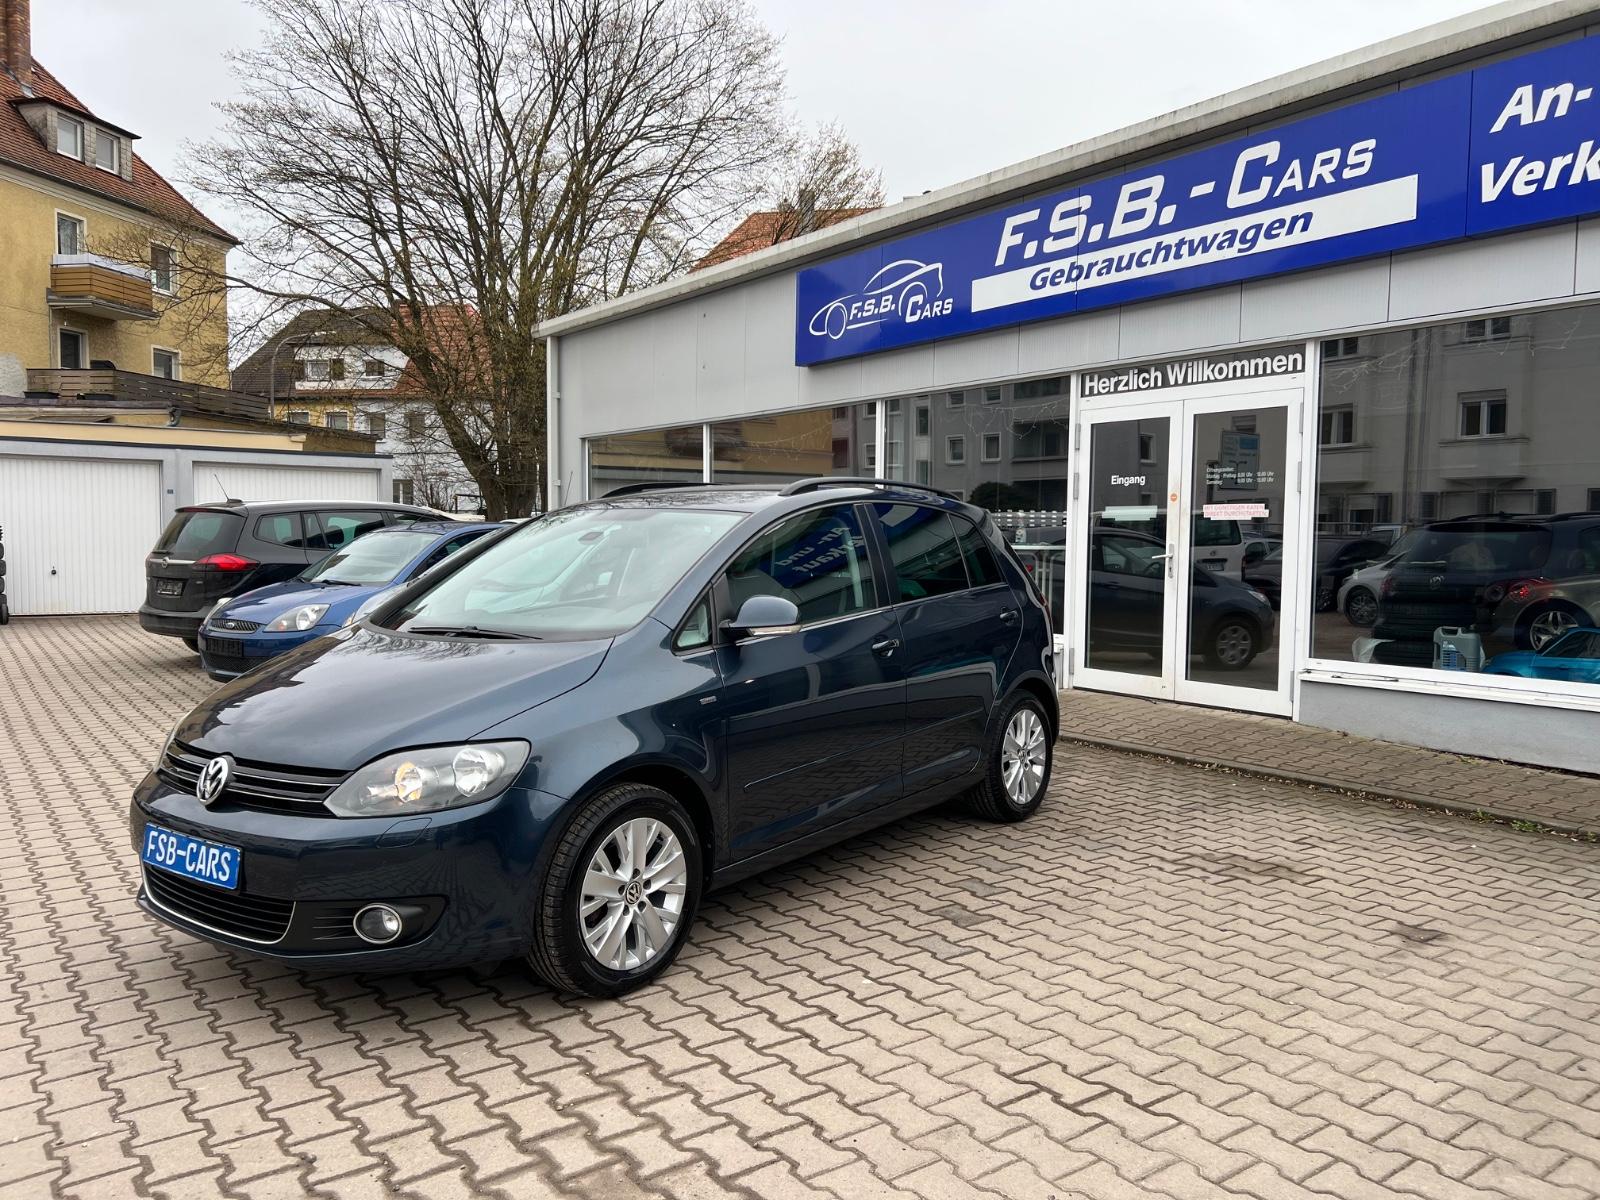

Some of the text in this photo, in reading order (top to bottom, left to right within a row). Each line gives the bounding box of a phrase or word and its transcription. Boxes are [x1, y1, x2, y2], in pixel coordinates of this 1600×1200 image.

[1489, 82, 1593, 134] An-
[1029, 210, 1314, 292] Gebrauchtwagen
[849, 294, 896, 321] F.S.B.
[1085, 353, 1303, 396] Herzlich Willkommen
[1111, 475, 1146, 486] Eingang
[146, 830, 232, 882] FSB-CARS
